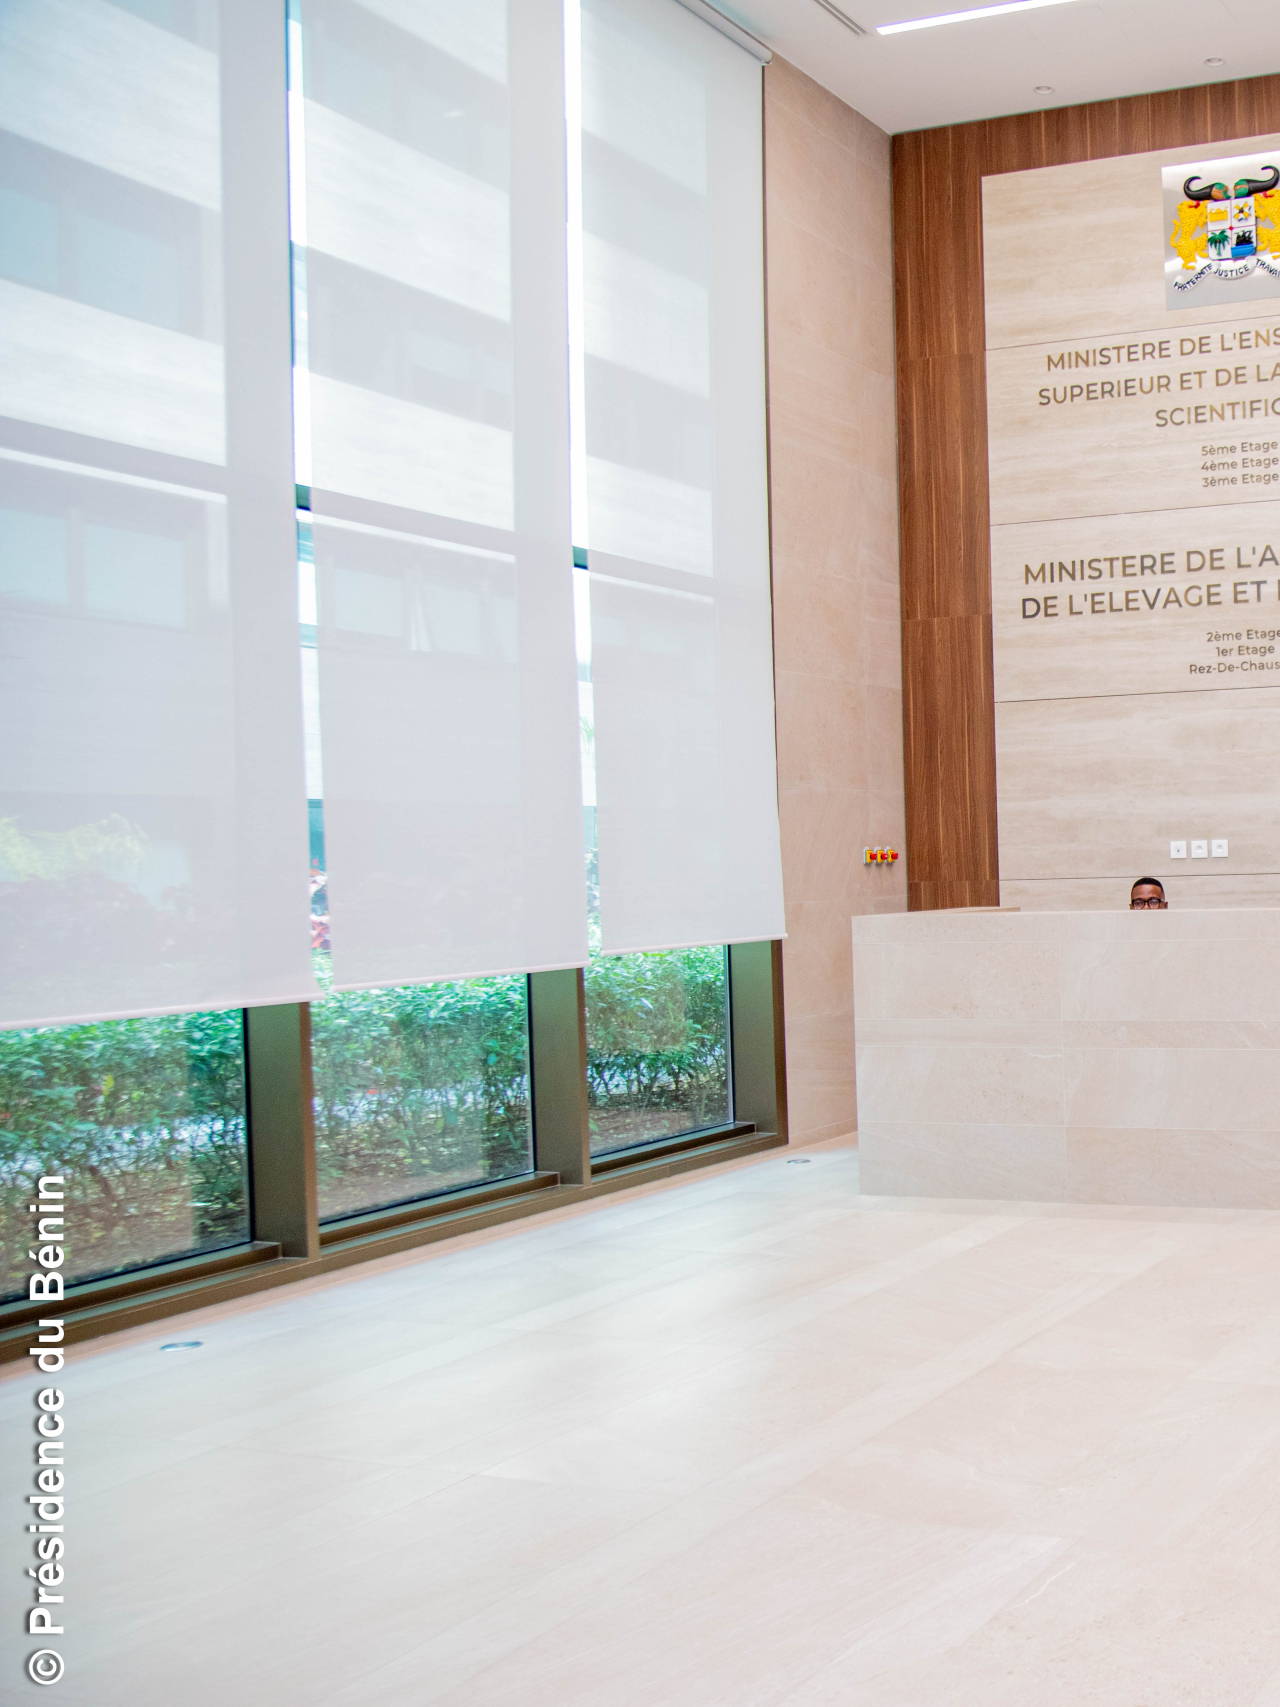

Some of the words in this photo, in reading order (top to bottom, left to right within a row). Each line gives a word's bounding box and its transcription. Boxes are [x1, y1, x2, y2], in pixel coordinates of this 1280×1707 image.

[1213, 263, 1250, 278] JUSTICE
[1046, 339, 1172, 372] MINISTERE
[1179, 335, 1212, 356] DE
[1038, 374, 1172, 406] SUPERIEUR
[1179, 370, 1207, 391] ET
[1215, 365, 1248, 387] DE
[1201, 444, 1237, 456] 5ème
[1240, 441, 1278, 453] Etage
[1201, 460, 1238, 471] 4ème
[1241, 457, 1279, 469] Etage
[1202, 476, 1238, 488] 3ème
[1241, 473, 1279, 485] Etage
[1024, 552, 1176, 585] MINISTERE
[1185, 548, 1225, 573] DE
[1021, 595, 1059, 620] DE
[1068, 583, 1223, 616] L'ELEVAGE
[1232, 580, 1268, 605] ET
[1206, 631, 1242, 643] 2ème
[1216, 646, 1234, 657] 1er
[1237, 645, 1275, 657] Etage
